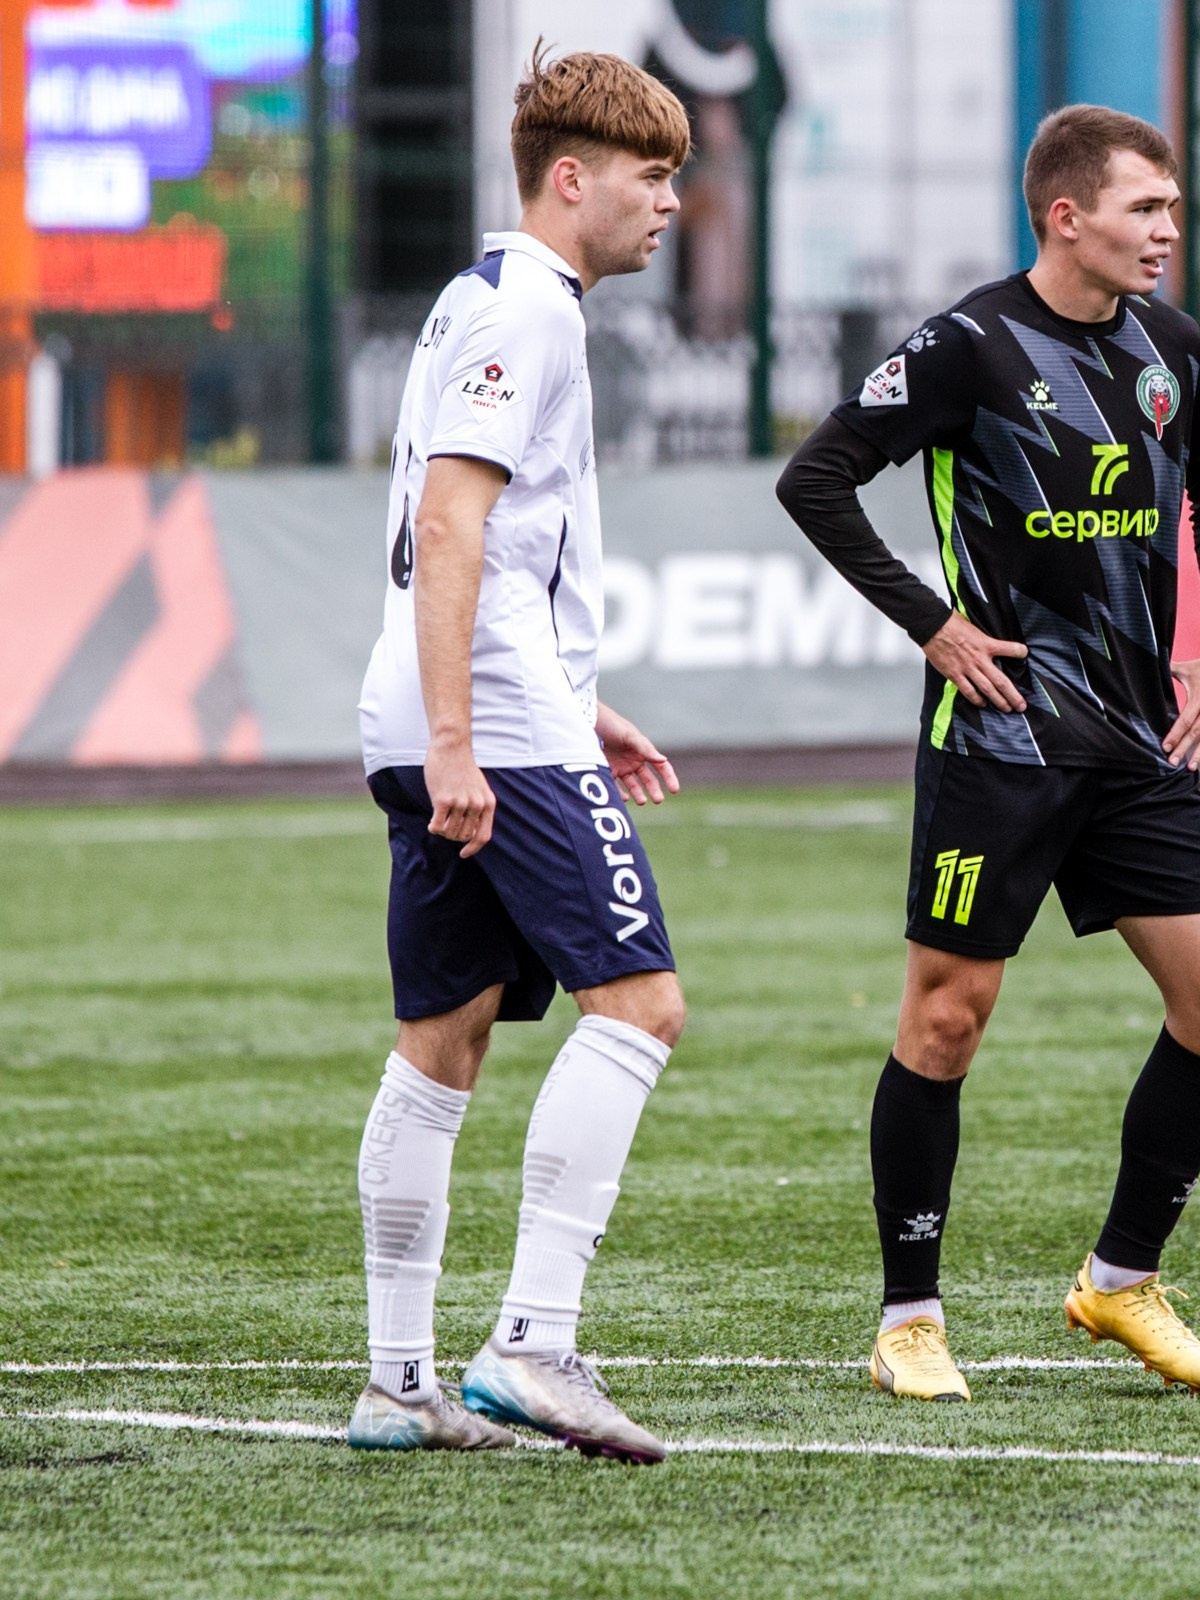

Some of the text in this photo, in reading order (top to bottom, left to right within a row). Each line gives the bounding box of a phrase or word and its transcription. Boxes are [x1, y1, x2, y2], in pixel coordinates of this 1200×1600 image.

[461, 381, 515, 401] LEON
[1026, 402, 1059, 410] KELME
[931, 849, 985, 926] 11
[361, 1091, 412, 1186] CIKERS
[899, 1229, 939, 1241] KELME
